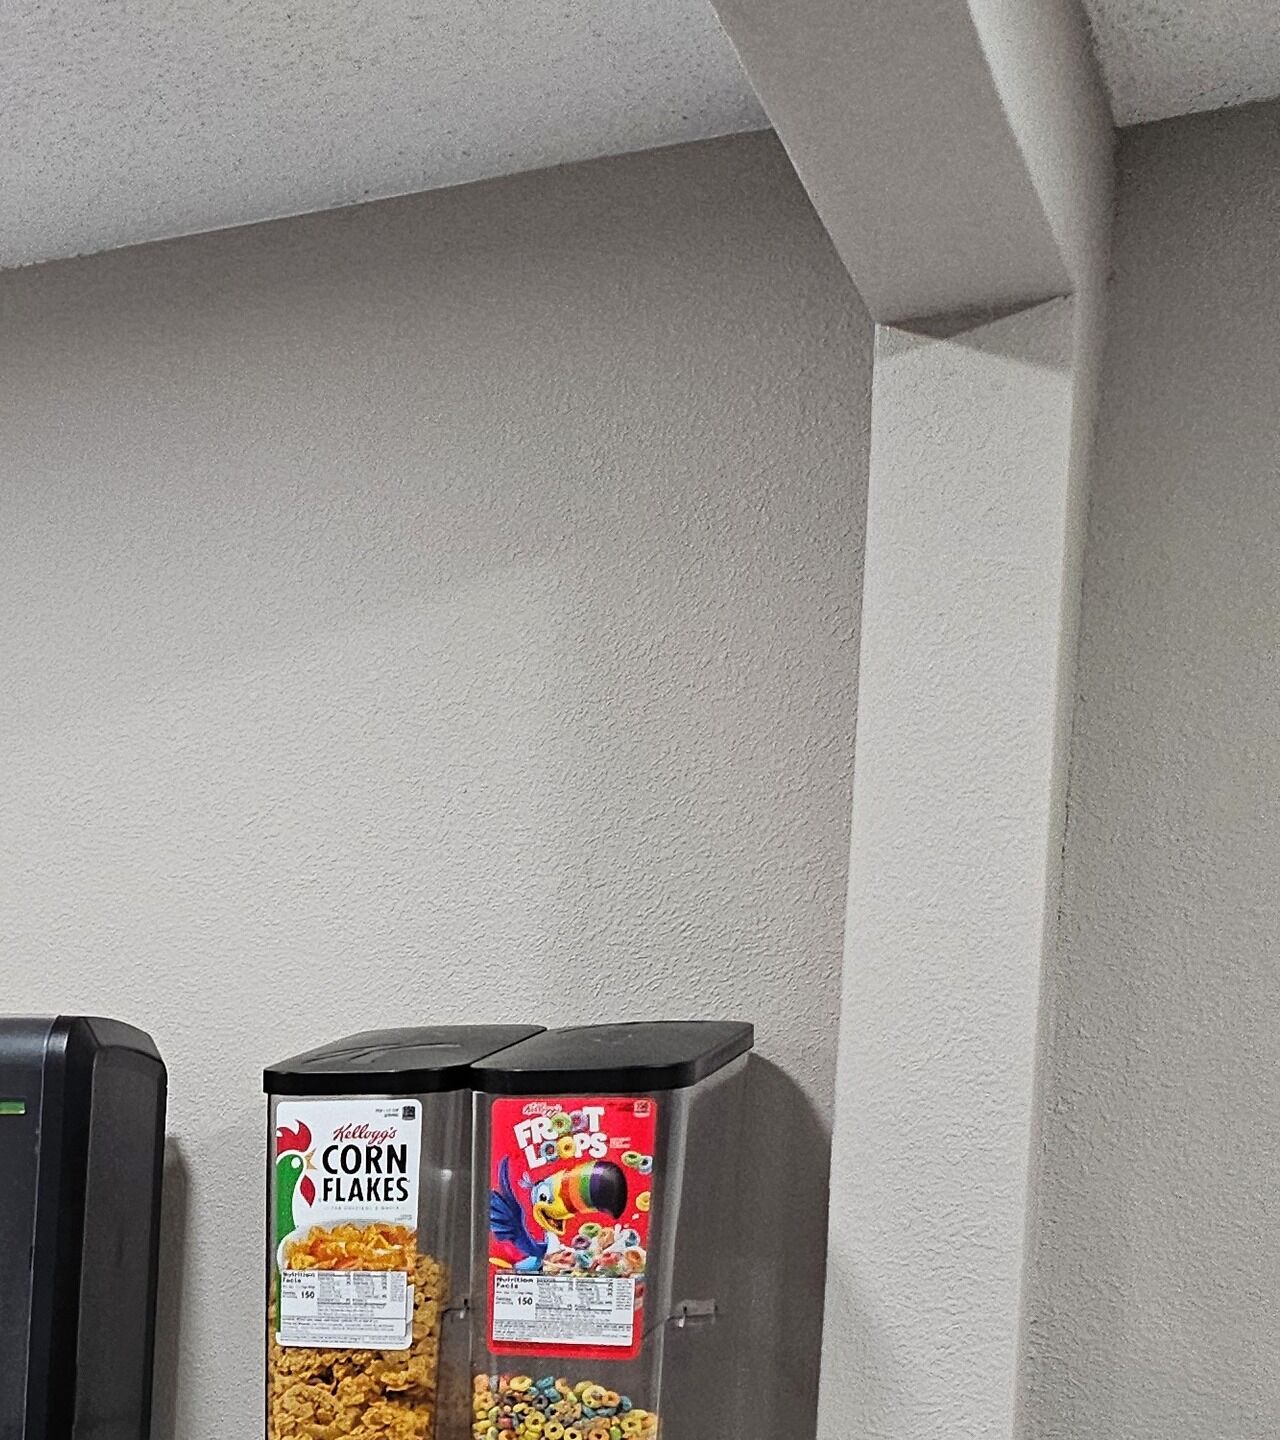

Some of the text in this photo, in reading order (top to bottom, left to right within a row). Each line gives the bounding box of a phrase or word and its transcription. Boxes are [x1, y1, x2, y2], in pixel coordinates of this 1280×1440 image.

[332, 1122, 398, 1145] Kellogg's
[513, 1106, 605, 1149] FROOT
[322, 1143, 407, 1175] CORN
[524, 1132, 608, 1169] LOOPS
[322, 1177, 410, 1202] FLAKES
[300, 1290, 315, 1299] 150
[517, 1297, 533, 1306] 150
